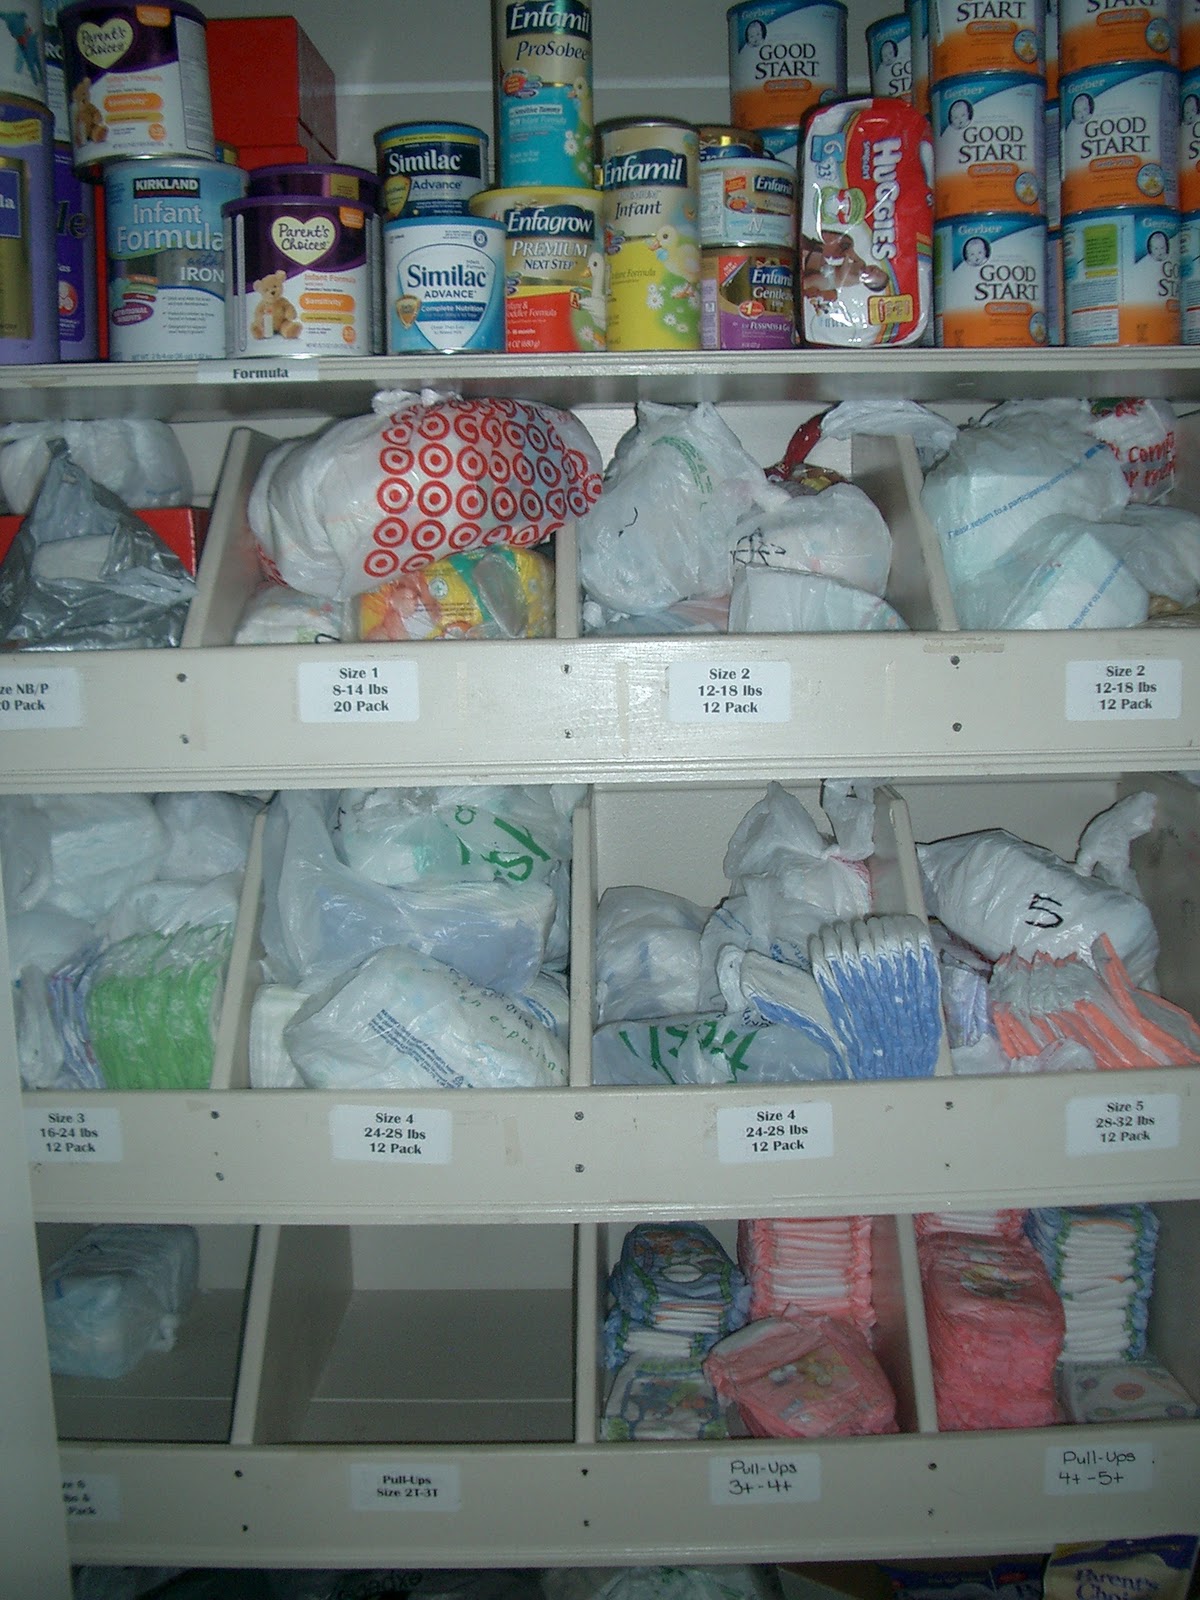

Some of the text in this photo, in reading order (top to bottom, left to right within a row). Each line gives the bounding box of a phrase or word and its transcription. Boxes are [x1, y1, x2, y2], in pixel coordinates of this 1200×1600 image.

[511, 3, 590, 33] Enfamil
[957, 2, 1026, 22] START
[516, 40, 587, 61] ProSobee
[759, 43, 816, 61] GOOD
[755, 61, 819, 79] START
[944, 85, 985, 99] Gerber
[1084, 116, 1146, 138] GOOD
[963, 125, 1023, 144] GOOD
[823, 140, 842, 154] 6
[959, 144, 1027, 163] START
[1080, 135, 1150, 159] START
[389, 149, 461, 175] Similac
[604, 156, 683, 186] Enfamil
[818, 163, 832, 178] 23
[136, 179, 198, 190] KIRKLAND
[411, 179, 461, 190] Advance
[871, 137, 902, 260] HUGGIES
[133, 201, 202, 224] Infant
[615, 201, 662, 220] Infant
[507, 209, 593, 234] Enfagrow
[279, 223, 330, 238] Parent's
[958, 224, 1002, 235] Gerber
[117, 222, 224, 252] Formula
[281, 238, 323, 250] Choice
[512, 240, 588, 257] PREMIUM
[524, 258, 575, 270] NEXT STEP
[180, 266, 225, 282] IRON
[407, 264, 486, 288] Similac
[752, 269, 793, 287] Enfami
[980, 264, 1036, 282] GOOD
[424, 290, 474, 299] ADVANCE
[974, 283, 1038, 301] START
[455, 304, 484, 312] Nutrition
[233, 368, 289, 379] Formula
[970, 512, 993, 528] return
[340, 667, 378, 679] Size 1
[709, 668, 750, 680] Size 2
[1106, 665, 1145, 677] Size 2
[17, 683, 49, 696] NB/P
[333, 684, 388, 696] 8-14 lbs
[698, 685, 763, 696] 12-18 lbs
[1095, 682, 1157, 693] 12-18 lbs
[0, 700, 46, 711] 0 Pack
[334, 700, 389, 712] 20 Pack
[703, 702, 758, 713] 12 Pack
[1100, 698, 1152, 710] 12 Pack
[1024, 893, 1064, 929] 5
[1107, 1101, 1144, 1113] Size 5
[48, 1113, 85, 1123] Size 3
[376, 1113, 414, 1124] Size 4
[757, 1110, 796, 1122] Size 4
[1096, 1115, 1155, 1128] 28-32 lbs
[40, 1128, 98, 1138] 16-24 lbs
[364, 1127, 426, 1140] 24-28 lbs
[746, 1125, 808, 1138] 24-28 lbs
[1101, 1131, 1151, 1142] 12 Pack
[46, 1143, 95, 1152] 12 Pack
[370, 1143, 422, 1154] 12 Pack
[752, 1140, 805, 1152] 12 Pack
[1063, 1450, 1136, 1466] Pull-Ups
[731, 1460, 798, 1476] Pull-Ups
[383, 1475, 432, 1486] Pull-Ups
[377, 1488, 439, 1497] Size 2T-3T
